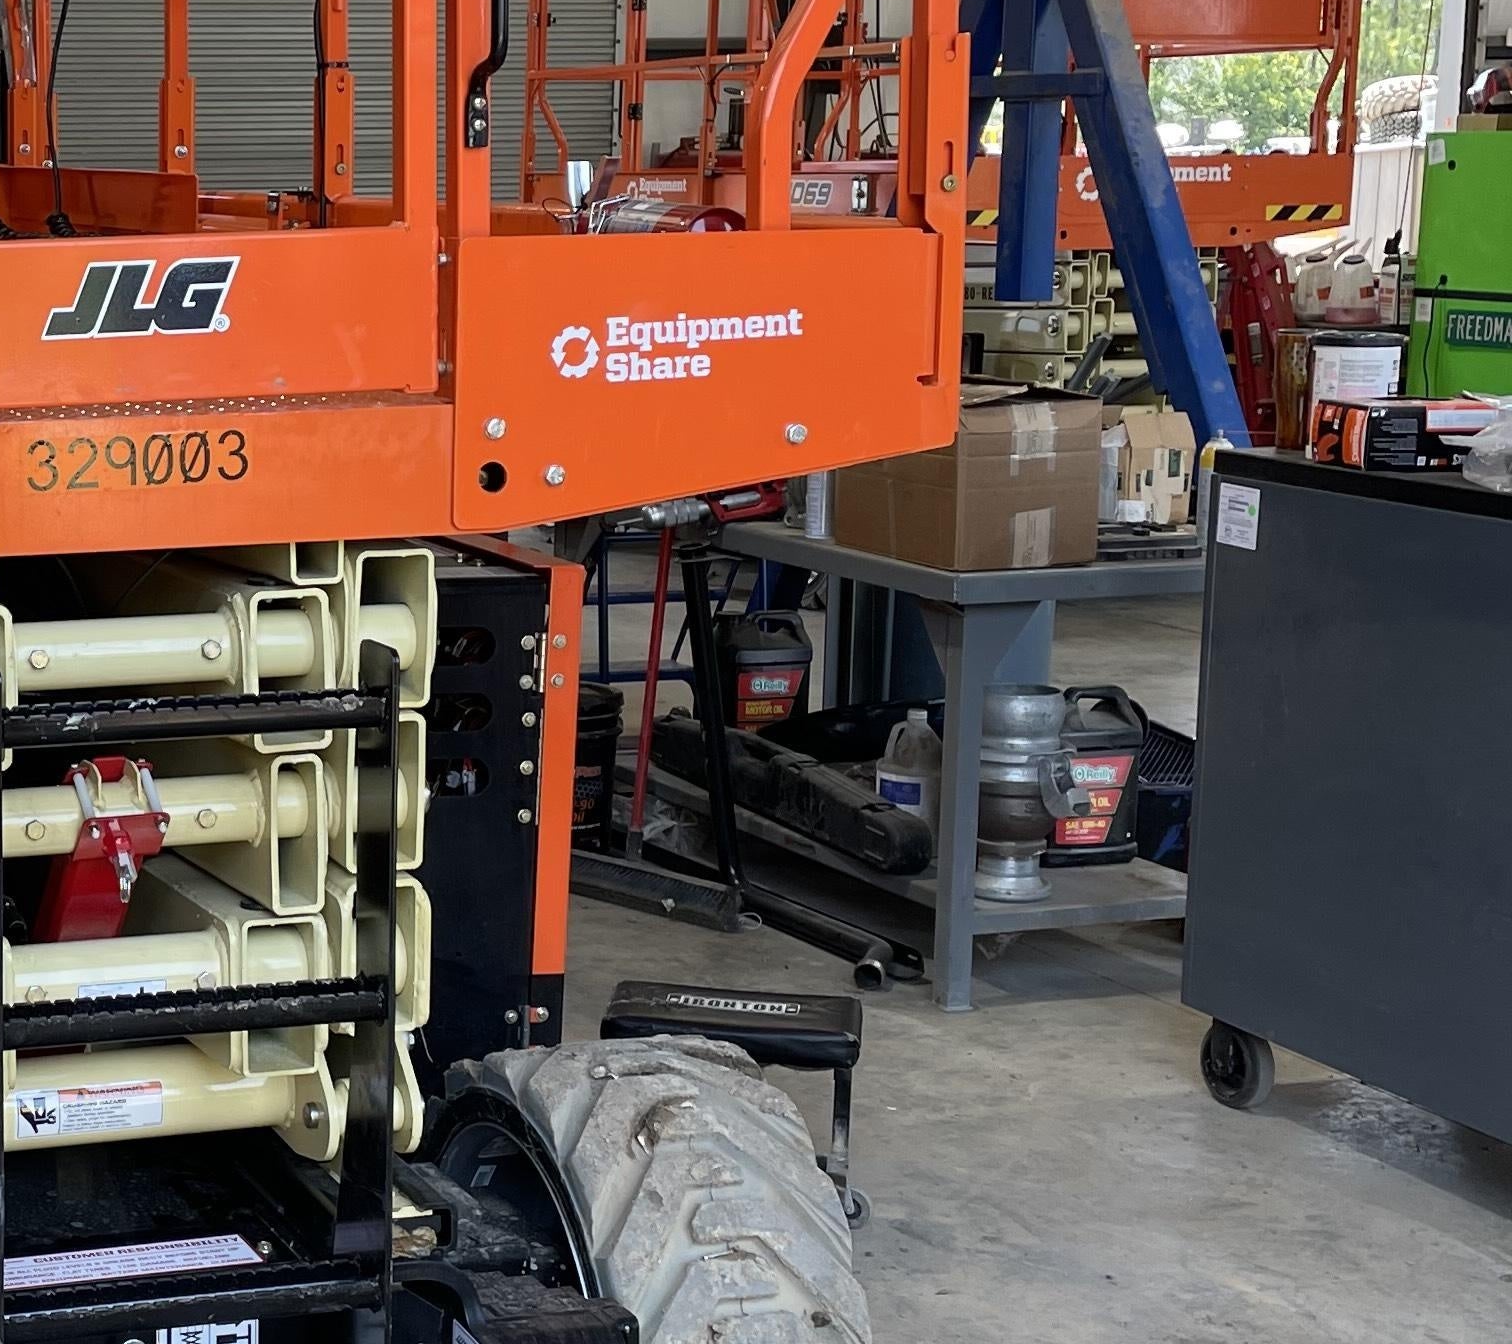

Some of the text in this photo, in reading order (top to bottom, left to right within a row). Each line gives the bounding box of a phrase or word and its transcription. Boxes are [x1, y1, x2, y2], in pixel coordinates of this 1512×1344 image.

[1170, 163, 1232, 182] ment
[42, 256, 241, 340] JLG
[605, 308, 804, 352] Equipment
[1447, 314, 1512, 343] FREEDMA
[605, 352, 711, 383] Share
[26, 430, 250, 492] 329003
[683, 995, 785, 1014] IRONTON
[33, 1237, 239, 1263] CUSTOMER RESPONSIBILITY
